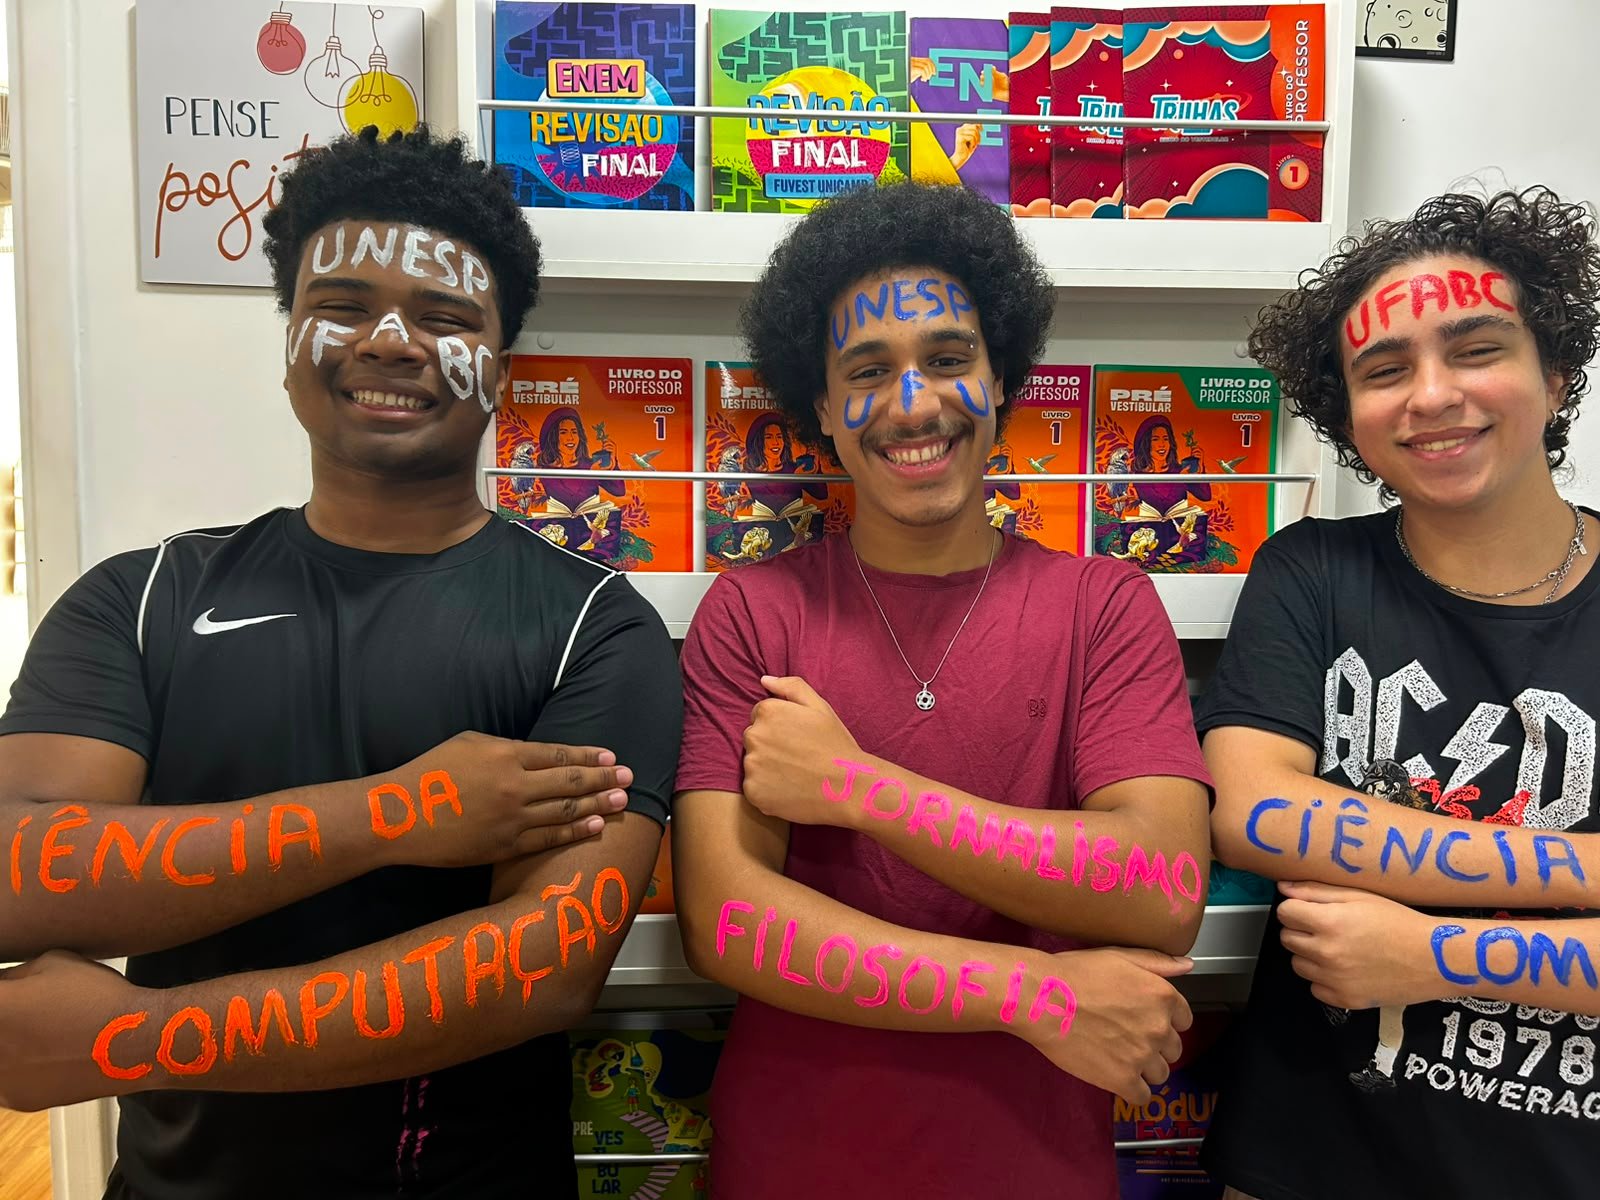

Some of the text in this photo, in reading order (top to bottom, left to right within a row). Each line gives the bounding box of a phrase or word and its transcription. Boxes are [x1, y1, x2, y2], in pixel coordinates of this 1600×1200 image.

[555, 62, 639, 94] ENEM
[1285, 75, 1294, 90] DO
[165, 96, 280, 139] PENSE
[771, 139, 867, 169] FINAL
[581, 152, 664, 178] FINAL
[1289, 166, 1299, 183] 1
[773, 179, 816, 193] FUVEST
[311, 225, 491, 296] UNESP
[831, 278, 974, 351] UNESP
[1345, 269, 1515, 350] UFABC
[608, 368, 683, 380] LIVRO DO
[1057, 376, 1081, 386] DO
[512, 377, 580, 394] PRÉ
[608, 380, 683, 395] PROFESSOR
[1200, 378, 1272, 389] LIVRO DO
[512, 393, 580, 405] VESTIBULAR
[1110, 386, 1172, 402] PRÉ
[1199, 389, 1271, 404] PROFESSOR
[1041, 410, 1071, 419] LIVRO
[1110, 401, 1172, 413] VESTIBULAR
[1232, 413, 1261, 421] LIVRO
[654, 415, 667, 441] 1
[1049, 420, 1062, 446] 1
[1240, 423, 1252, 448] 1
[368, 769, 464, 840] DA
[1431, 925, 1599, 990] COM
[92, 867, 631, 1080] COMPUTAÇÃO
[715, 900, 1079, 1038] FILOSOFIA
[1441, 1011, 1596, 1085] 1978
[595, 1131, 624, 1145] VES
[592, 1179, 621, 1194] LAR
